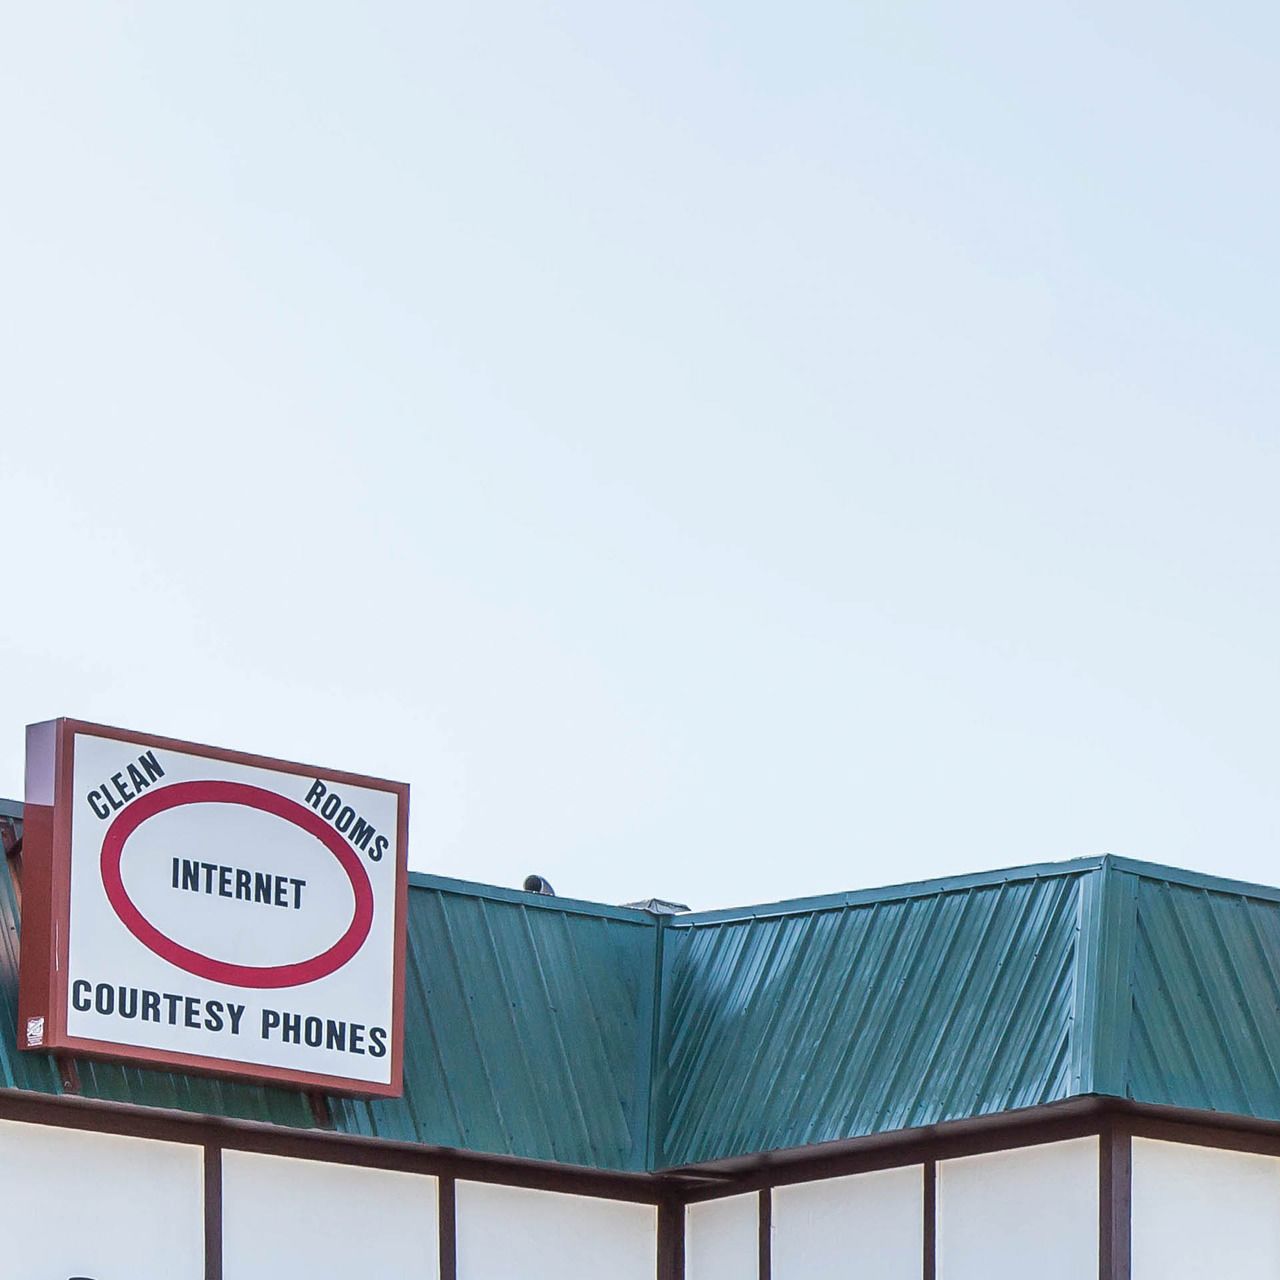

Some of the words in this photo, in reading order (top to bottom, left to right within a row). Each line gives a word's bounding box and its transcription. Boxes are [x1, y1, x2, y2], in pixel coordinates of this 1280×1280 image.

[87, 750, 165, 820] CLEAN
[304, 778, 389, 862] ROOMS
[172, 857, 307, 910] INTERNET
[72, 979, 246, 1035] COURTESY
[261, 1008, 387, 1058] PHONES
